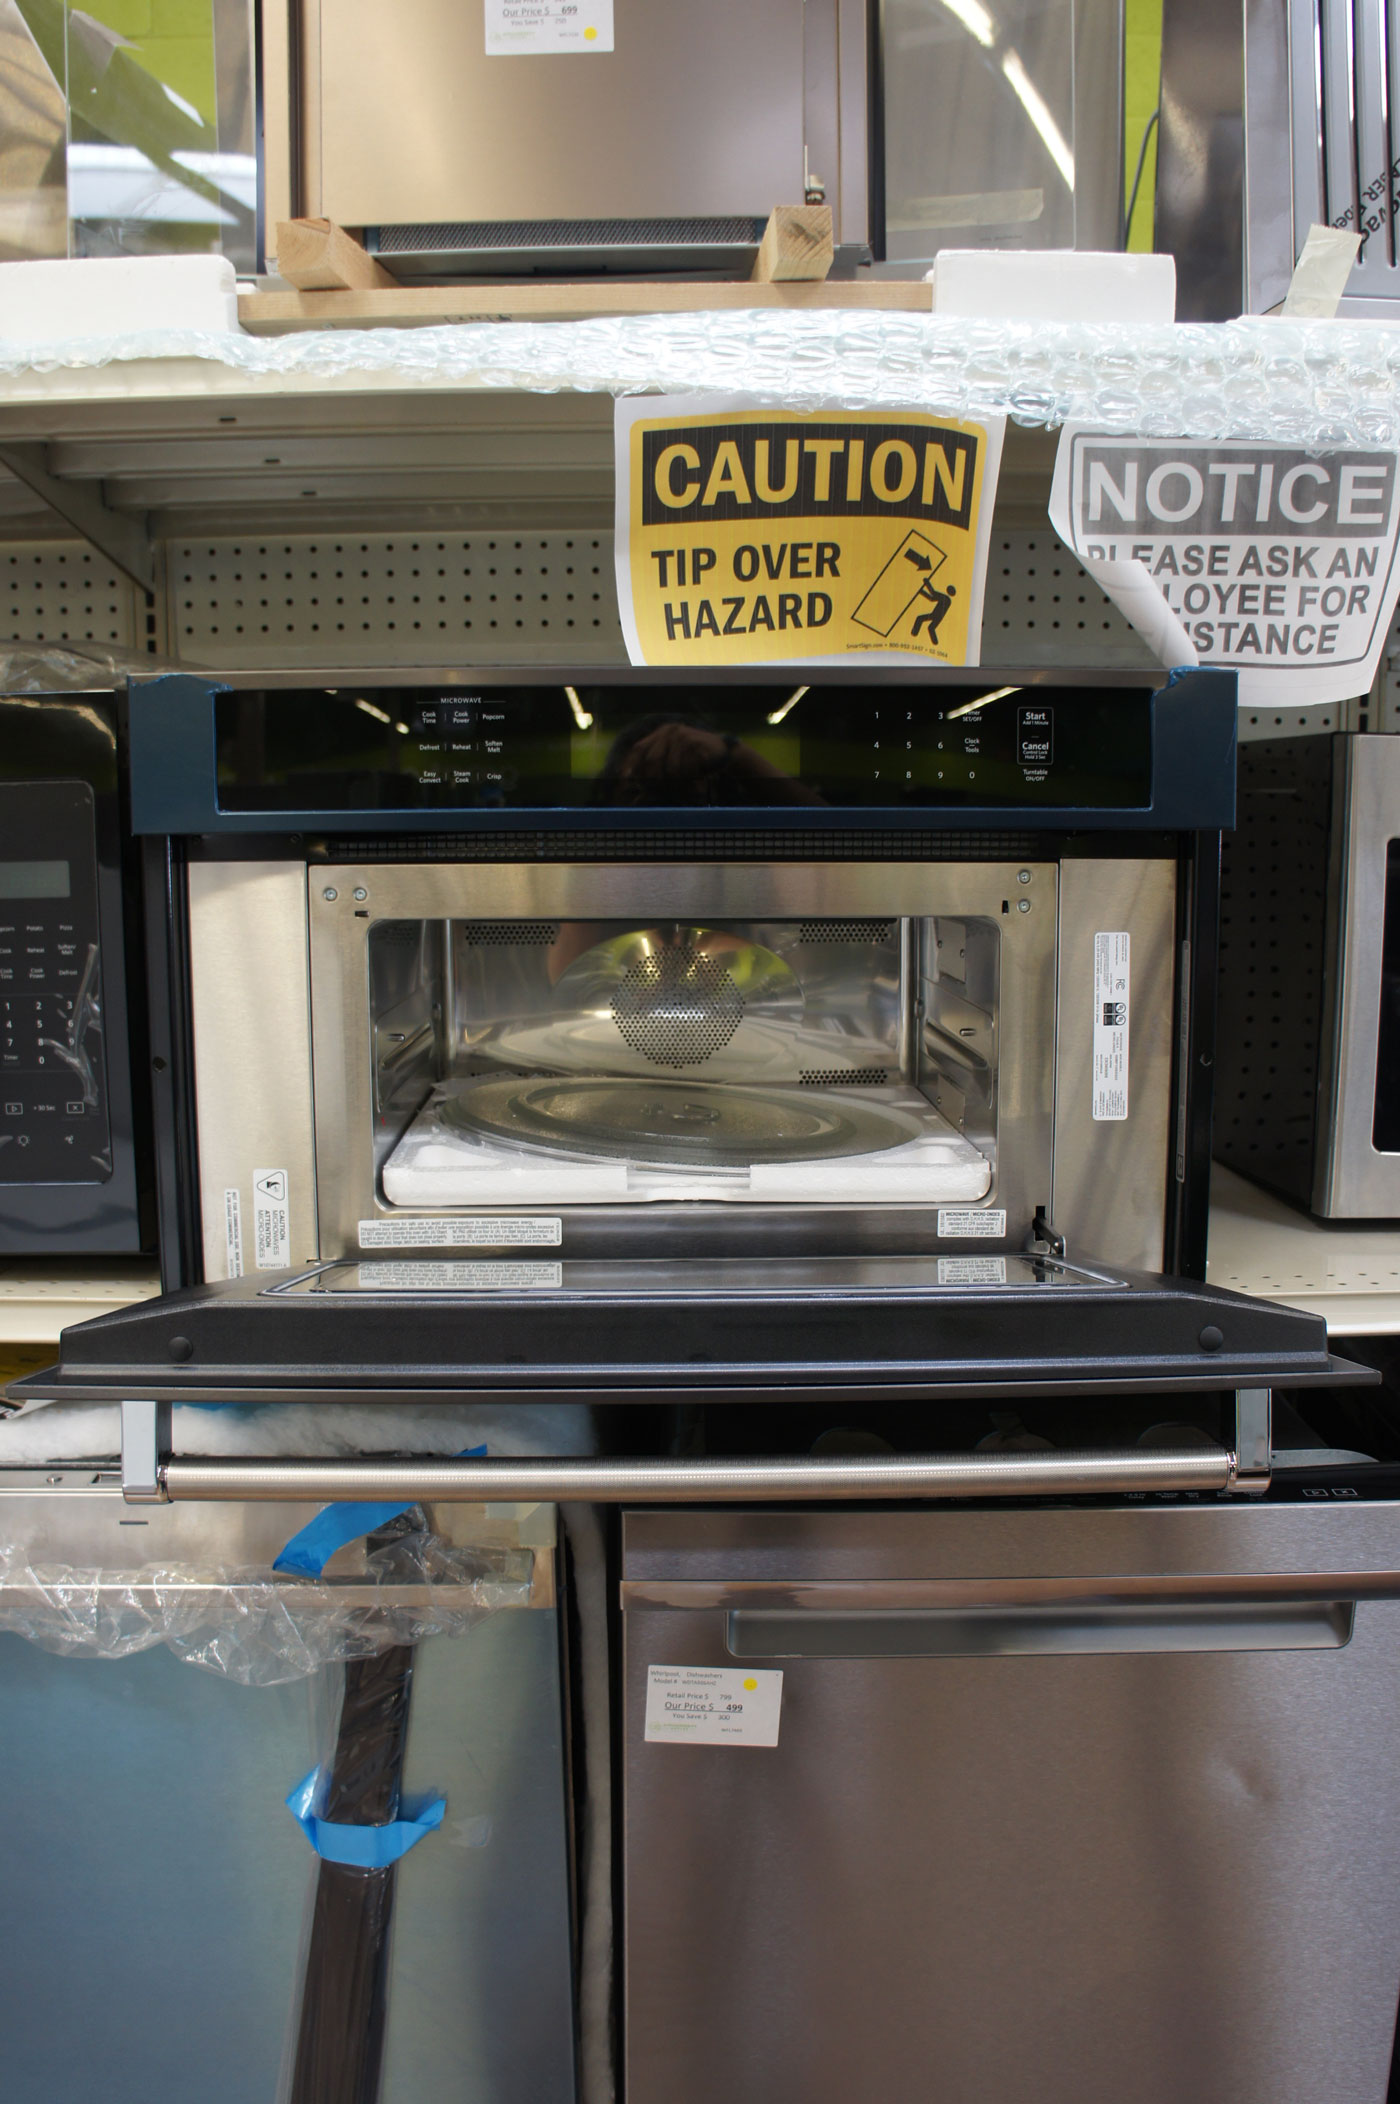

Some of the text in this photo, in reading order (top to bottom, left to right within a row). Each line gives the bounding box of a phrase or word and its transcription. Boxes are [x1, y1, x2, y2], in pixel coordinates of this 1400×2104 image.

[503, 6, 577, 16] Our Price $ 699
[654, 440, 966, 512] CAUTION
[1088, 462, 1388, 524] NOTICE
[651, 542, 841, 588] TIP OVER
[1237, 546, 1326, 578] ASK
[1326, 546, 1380, 578] AN
[1162, 584, 1370, 617] LOYEE FOR
[664, 592, 833, 640] HAZARD
[906, 712, 912, 720] 2
[938, 712, 943, 720] 3
[1025, 712, 1046, 720] Start
[1022, 742, 1049, 750] Cancel
[938, 771, 943, 779] 9
[5, 1002, 10, 1010] 1
[36, 1002, 42, 1010] 2
[67, 1001, 73, 1009] 3
[37, 1020, 42, 1028] 5
[68, 1019, 74, 1027] 6
[8, 1039, 13, 1047] 7
[38, 1038, 44, 1046] 8
[69, 1038, 74, 1046] 9
[39, 1057, 45, 1065] 0
[665, 1702, 681, 1710] Our
[684, 1702, 706, 1711] Price
[709, 1703, 714, 1711] $
